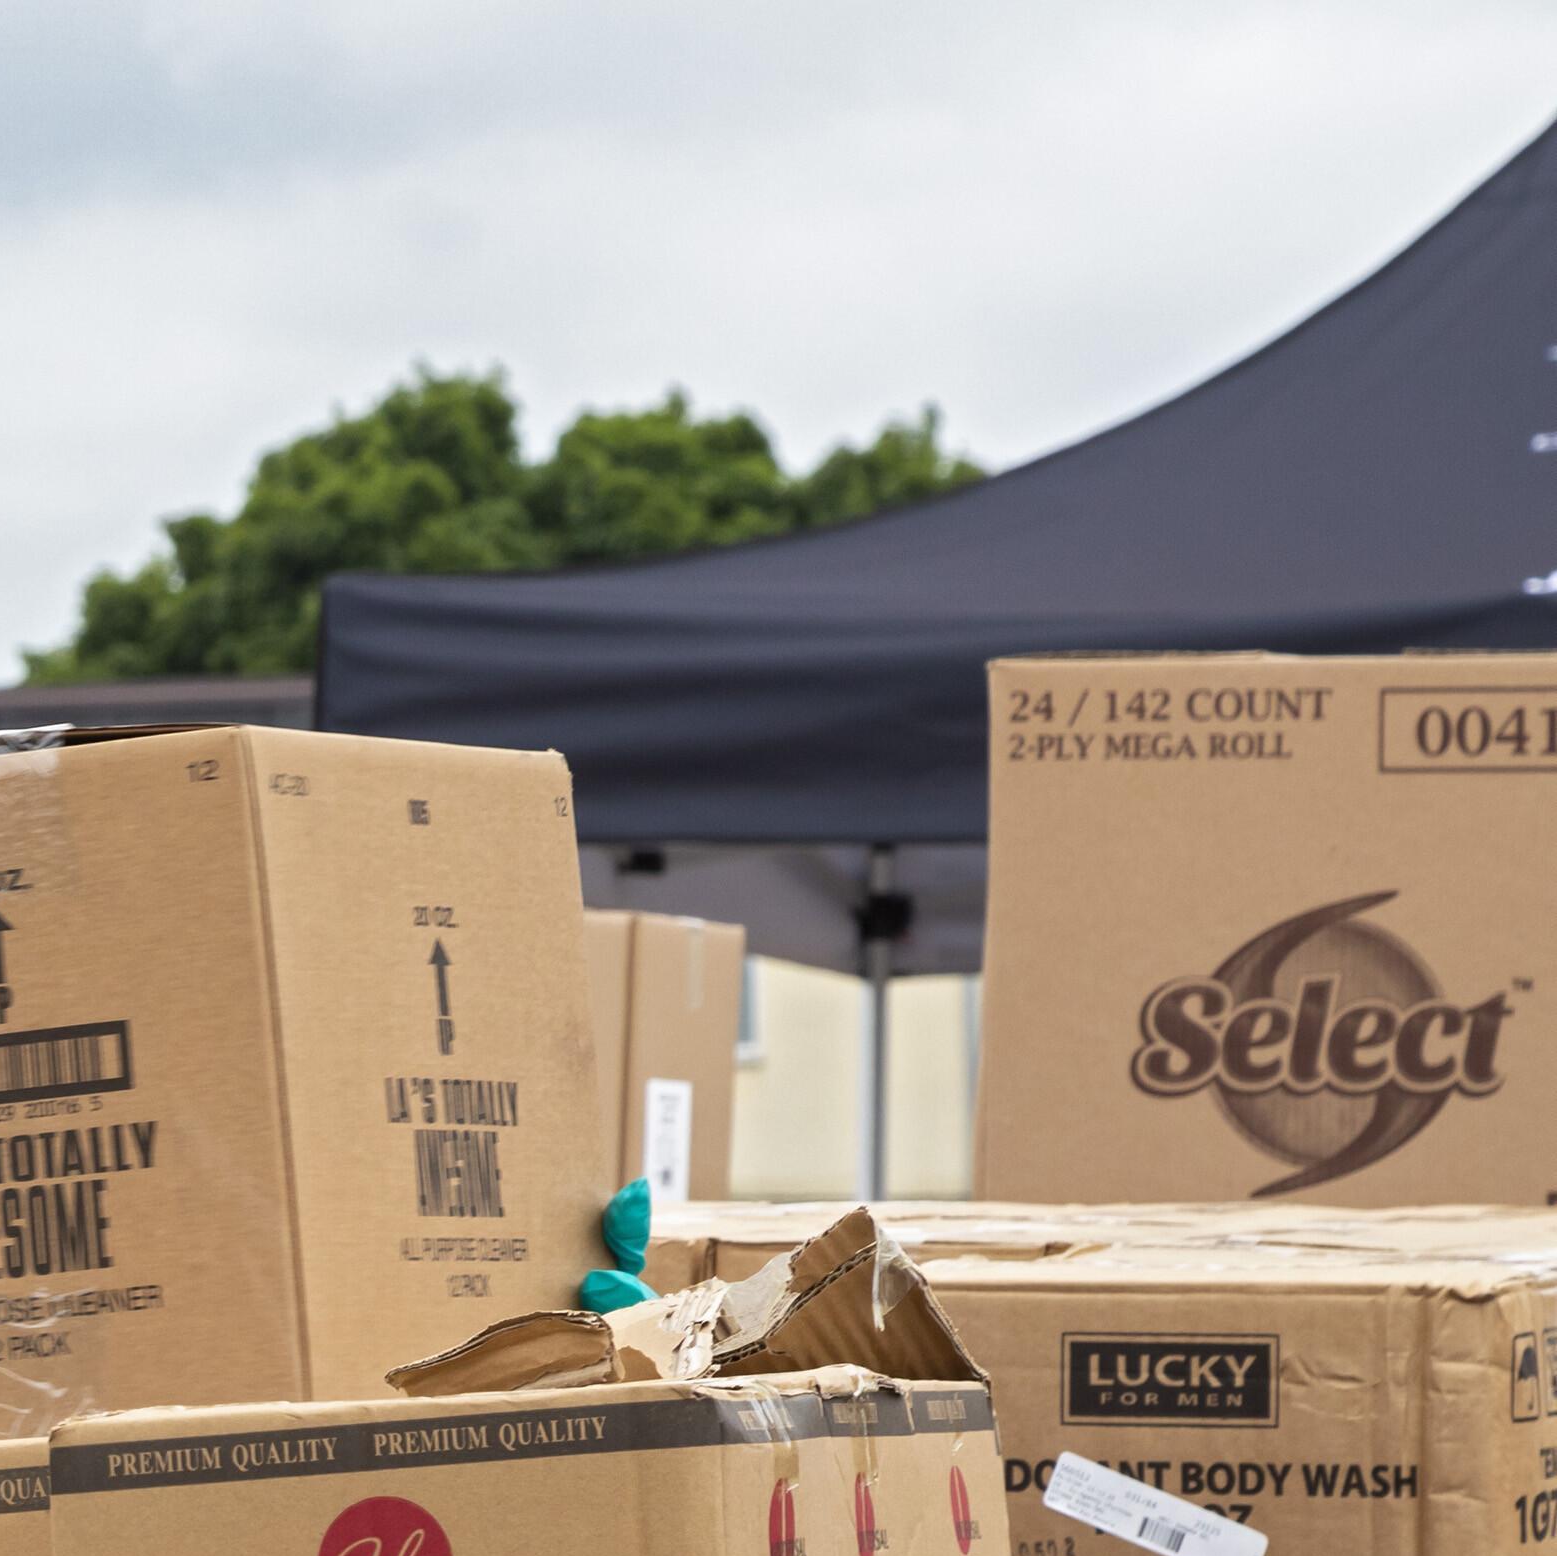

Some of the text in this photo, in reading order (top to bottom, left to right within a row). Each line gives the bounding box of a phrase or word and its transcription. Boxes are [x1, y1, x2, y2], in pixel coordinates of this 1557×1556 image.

[1008, 689, 1333, 727] 24 / 142 COUNT
[1008, 733, 1293, 761] 2-PLY MEGA ROLL
[1131, 975, 1514, 1097] Select
[1089, 1354, 1257, 1389] LUCKY
[1100, 1393, 1243, 1407] FOR MEN
[108, 1437, 338, 1476] PREMIUM QUALITY
[1181, 1463, 1293, 1496] BODY
[1303, 1465, 1419, 1498] WASH
